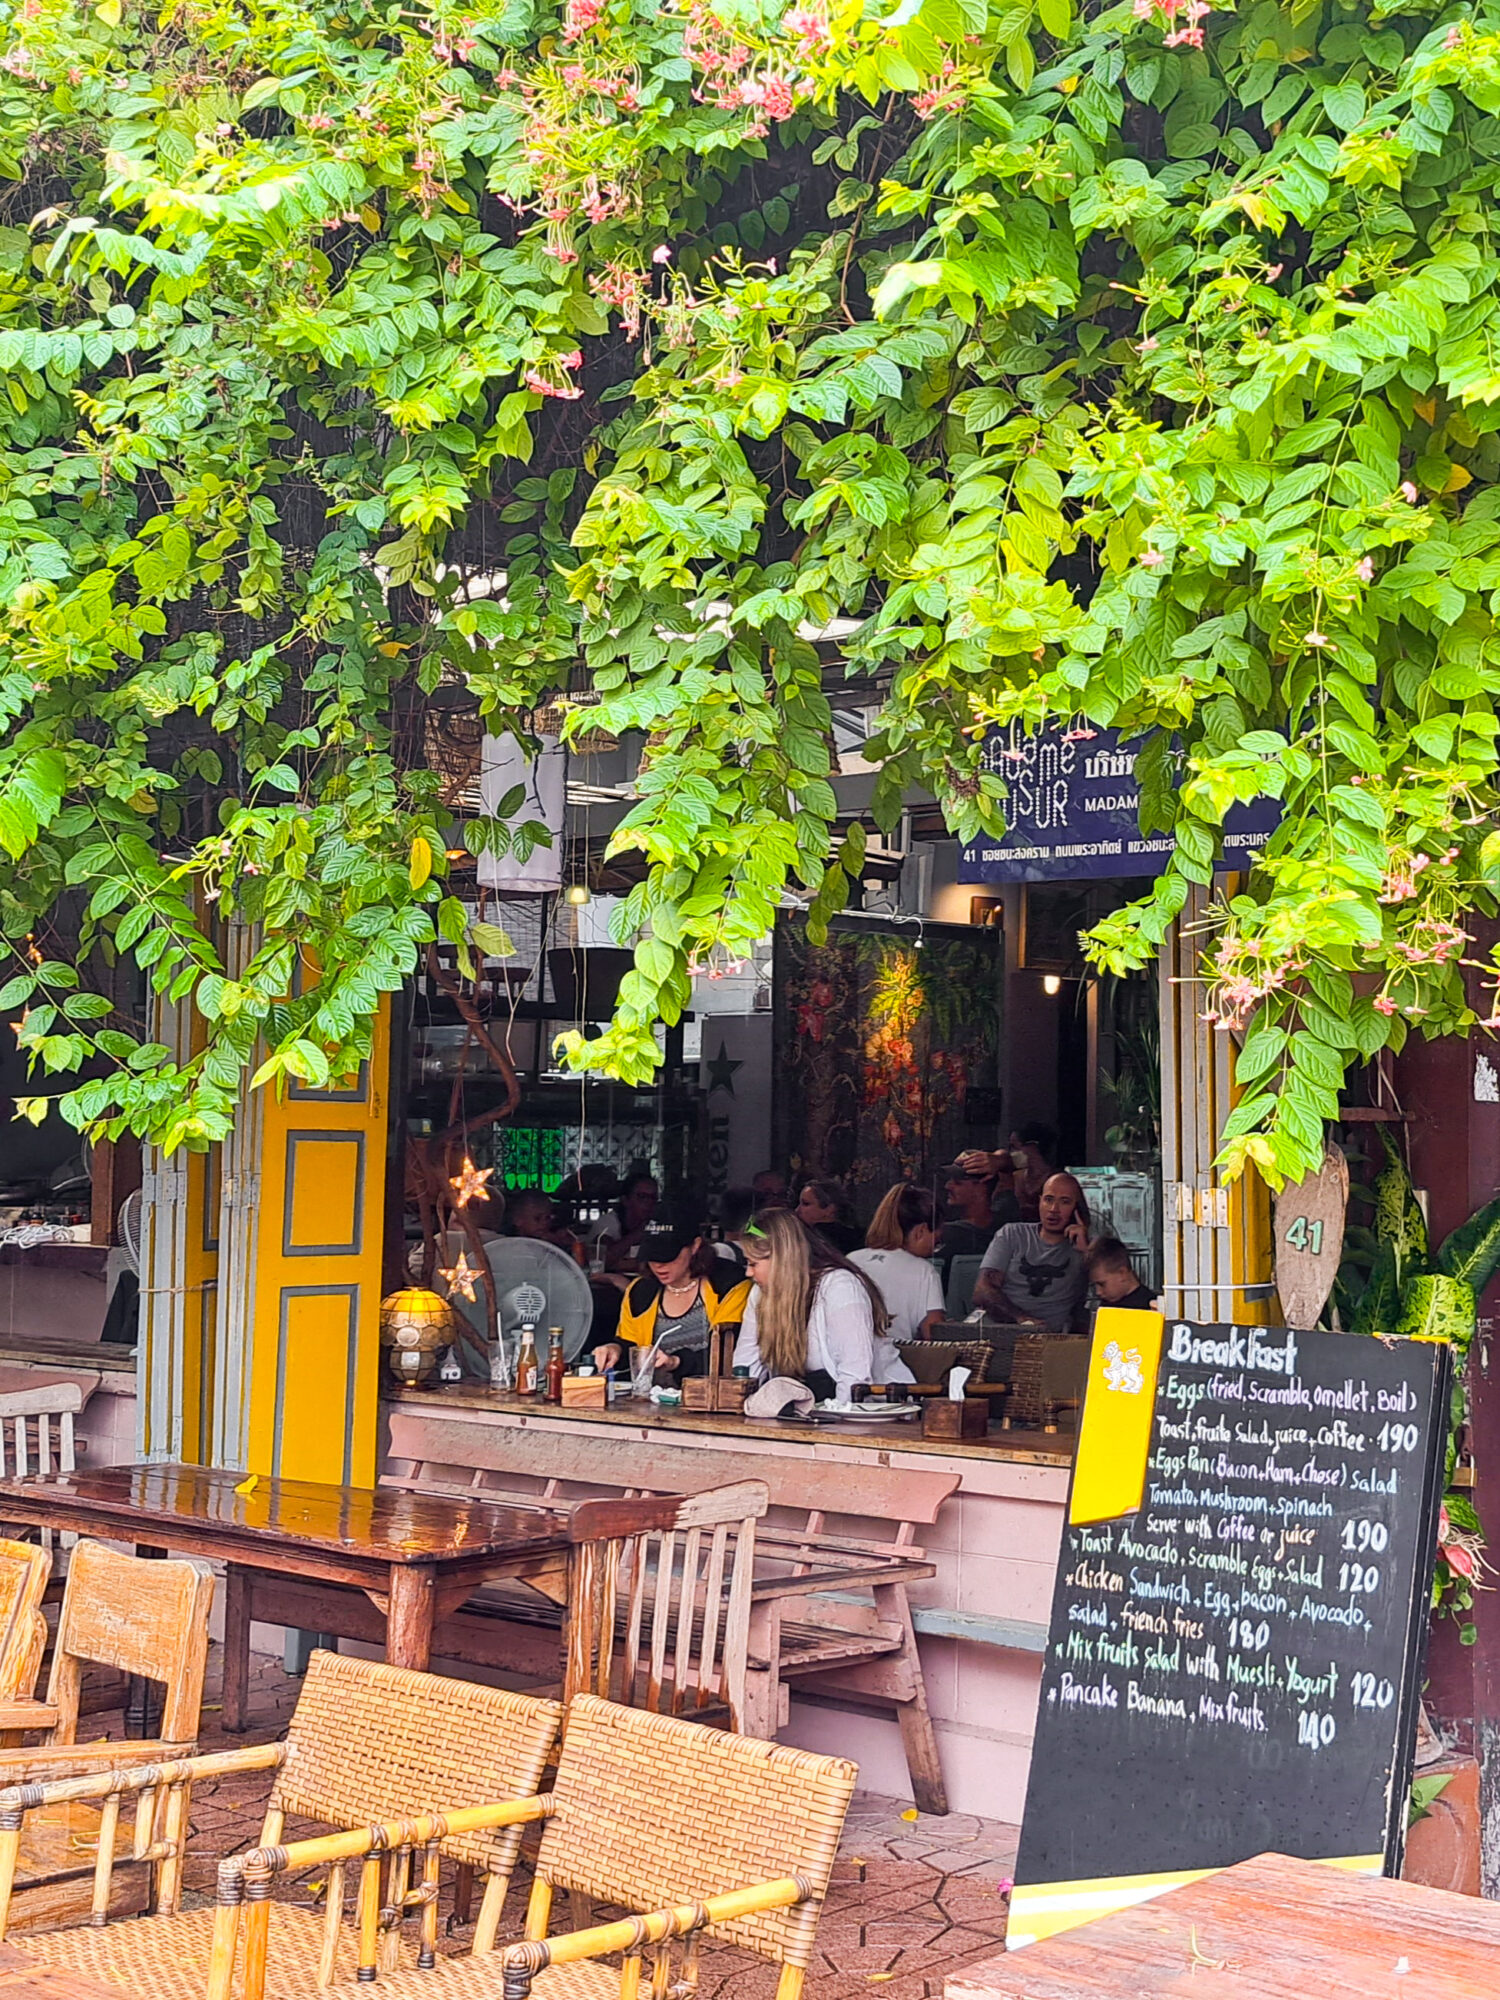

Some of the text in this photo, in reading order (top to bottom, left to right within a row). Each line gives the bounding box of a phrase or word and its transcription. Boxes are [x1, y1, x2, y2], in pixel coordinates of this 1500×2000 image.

[963, 849, 976, 863] 41
[1286, 1217, 1323, 1254] 41
[1166, 1375, 1205, 1409] Eggs
[1377, 1421, 1418, 1452] 190
[1156, 1447, 1186, 1478] Eggs
[1188, 1446, 1209, 1475] Pan
[1185, 1514, 1212, 1539] with
[1260, 1527, 1275, 1544] or
[1274, 1523, 1317, 1562] juice
[1340, 1519, 1388, 1553] 190
[1075, 1560, 1123, 1592] Chicken
[1080, 1525, 1114, 1552] Toast
[1339, 1562, 1379, 1593] 120
[1228, 1618, 1270, 1652] 180
[1067, 1630, 1093, 1661] Mix
[1097, 1630, 1139, 1668] fruits
[1186, 1644, 1219, 1682] with
[1350, 1671, 1394, 1709] 120
[1061, 1672, 1117, 1708] Pancake
[1298, 1710, 1335, 1750] 140
